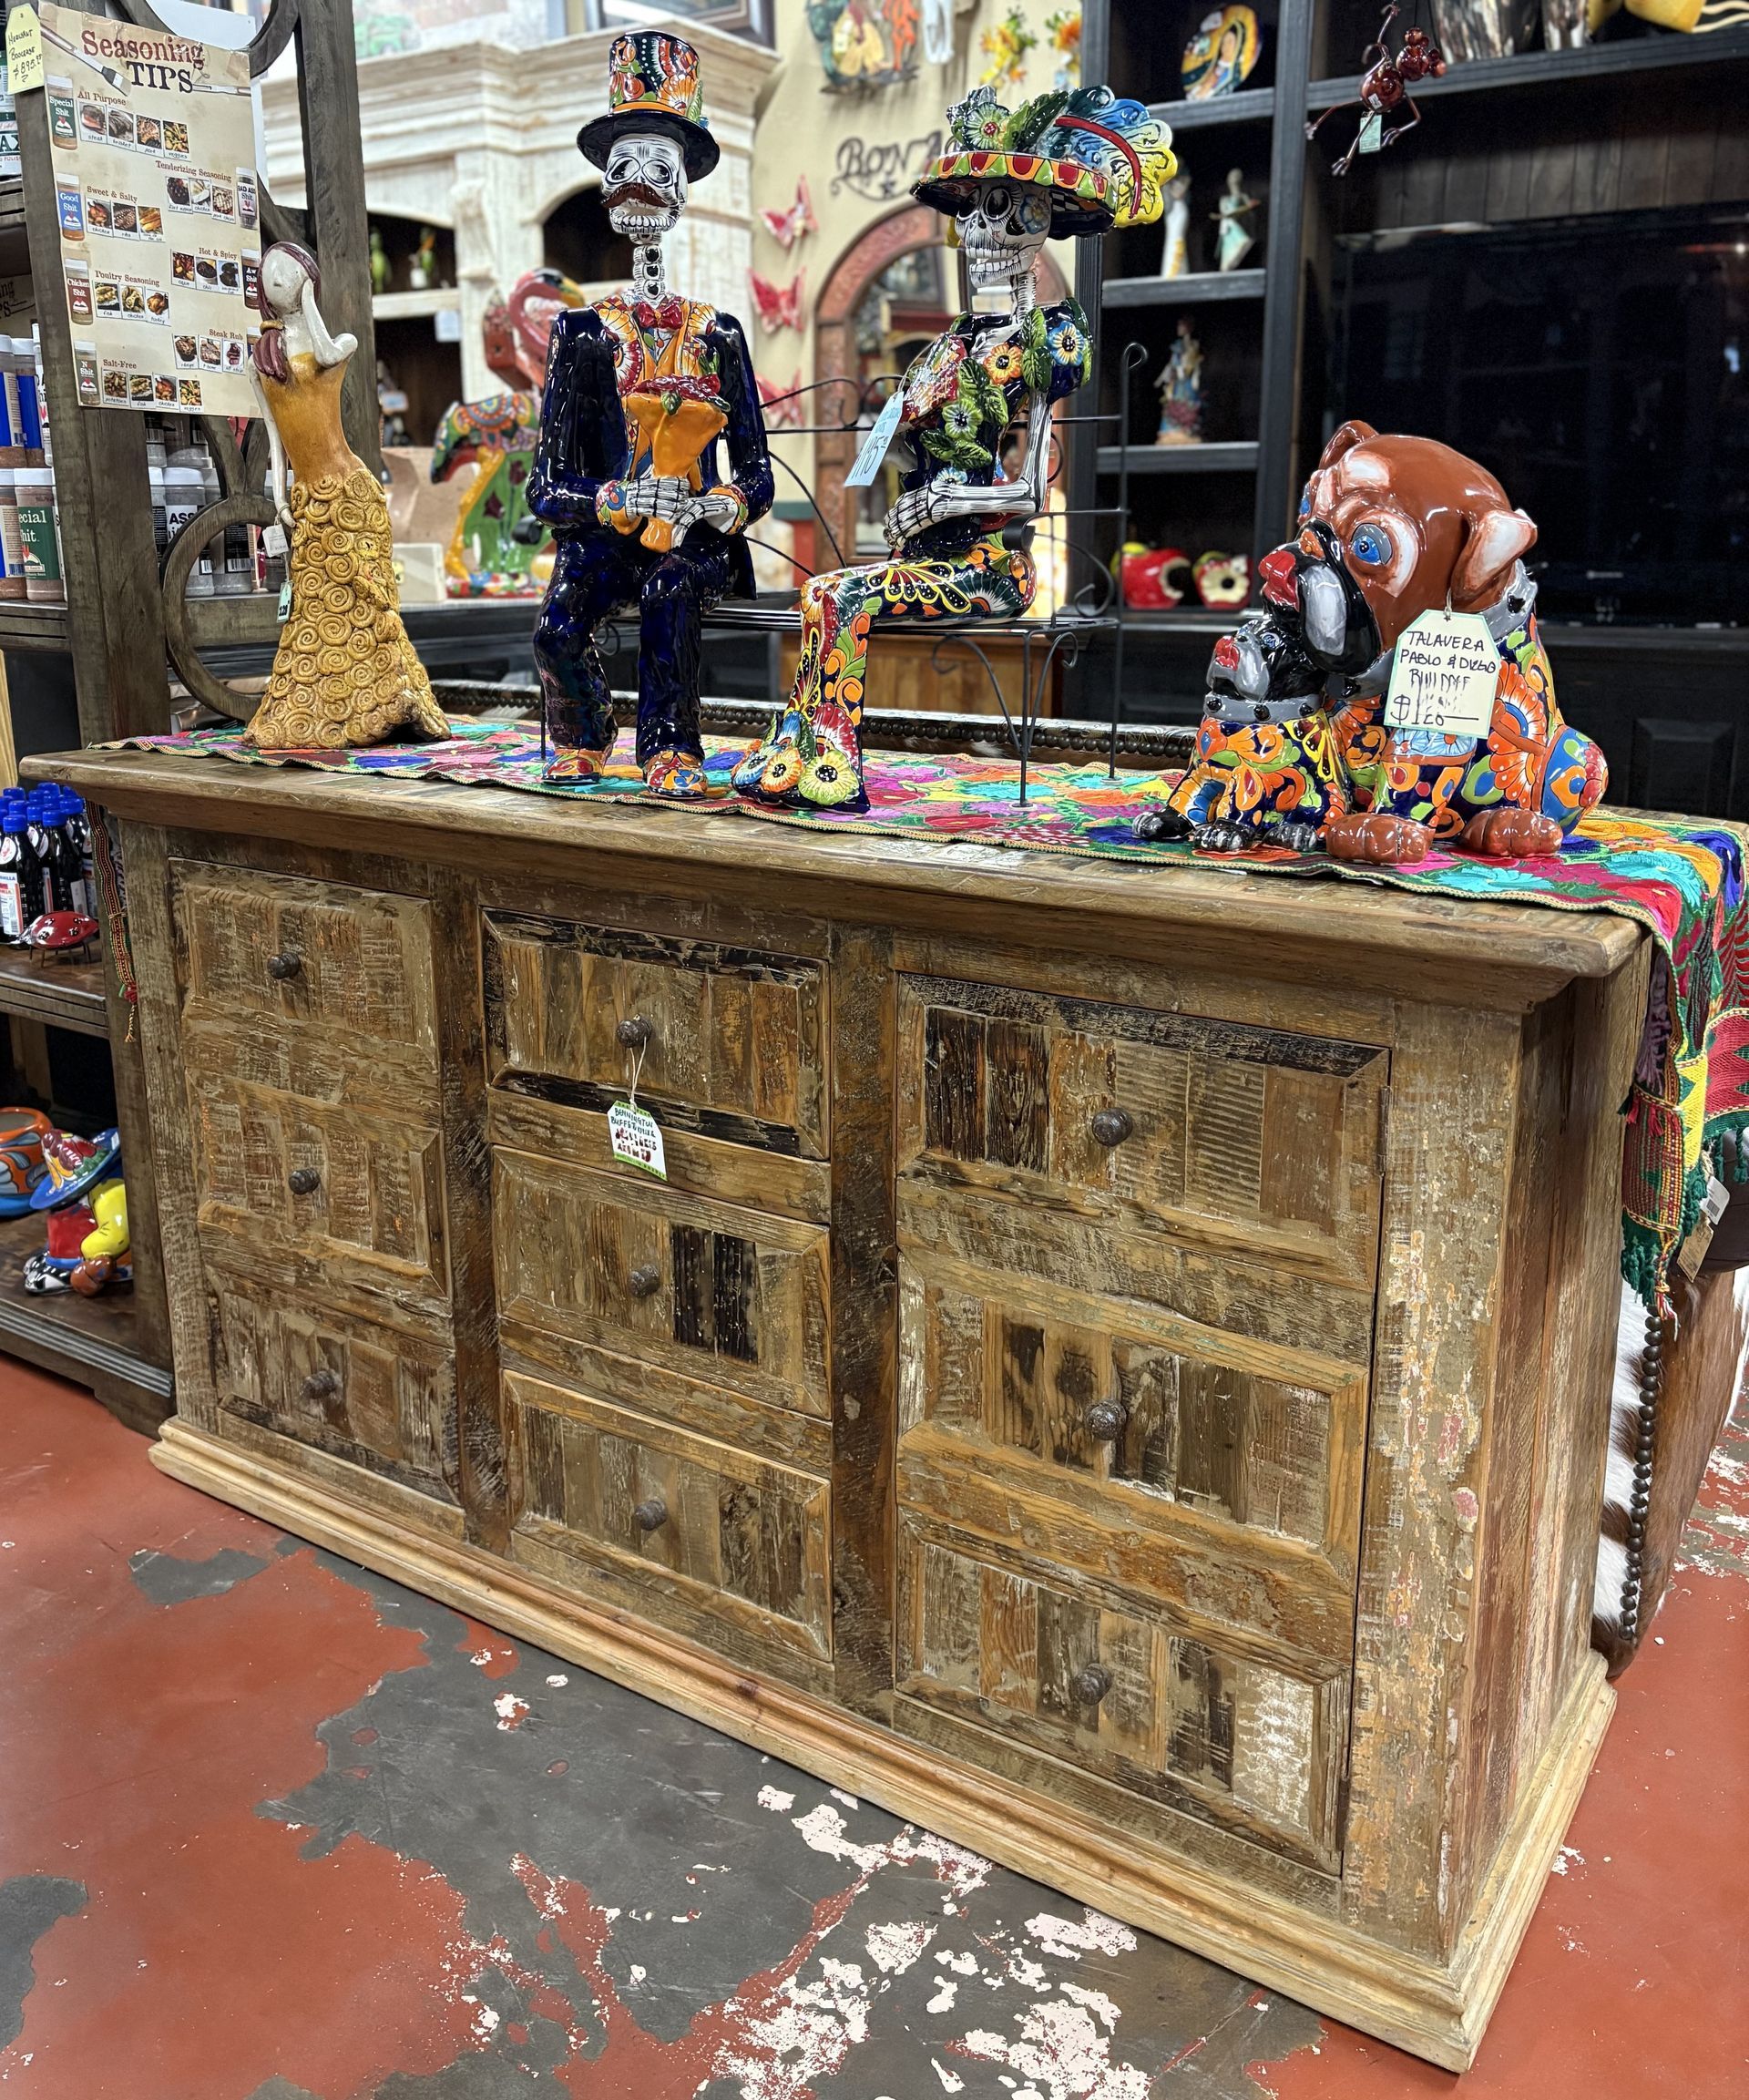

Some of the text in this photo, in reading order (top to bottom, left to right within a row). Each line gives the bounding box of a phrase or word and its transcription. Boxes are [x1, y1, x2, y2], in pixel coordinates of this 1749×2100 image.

[81, 30, 205, 70] Seasoning
[126, 60, 193, 93] TIPS
[50, 96, 73, 108] Special
[77, 91, 126, 106] All Purpose
[56, 108, 70, 117] Shit
[155, 160, 232, 183] Tenderizing Seasoning
[60, 192, 78, 203] Good
[87, 185, 109, 196] Sweet
[119, 192, 138, 204] Salty
[63, 203, 78, 211] Shit
[220, 250, 237, 261] Spicy
[95, 270, 160, 288] Poultry Seasoning
[72, 288, 87, 297] Shit
[209, 329, 227, 338] Steak
[103, 359, 137, 369] Salt-Free
[80, 368, 94, 376] Shit
[19, 510, 46, 523] ecial
[20, 529, 36, 542] hit
[1406, 631, 1484, 651] TALAVERA
[1400, 649, 1441, 666] PABLO
[1447, 654, 1457, 669] &
